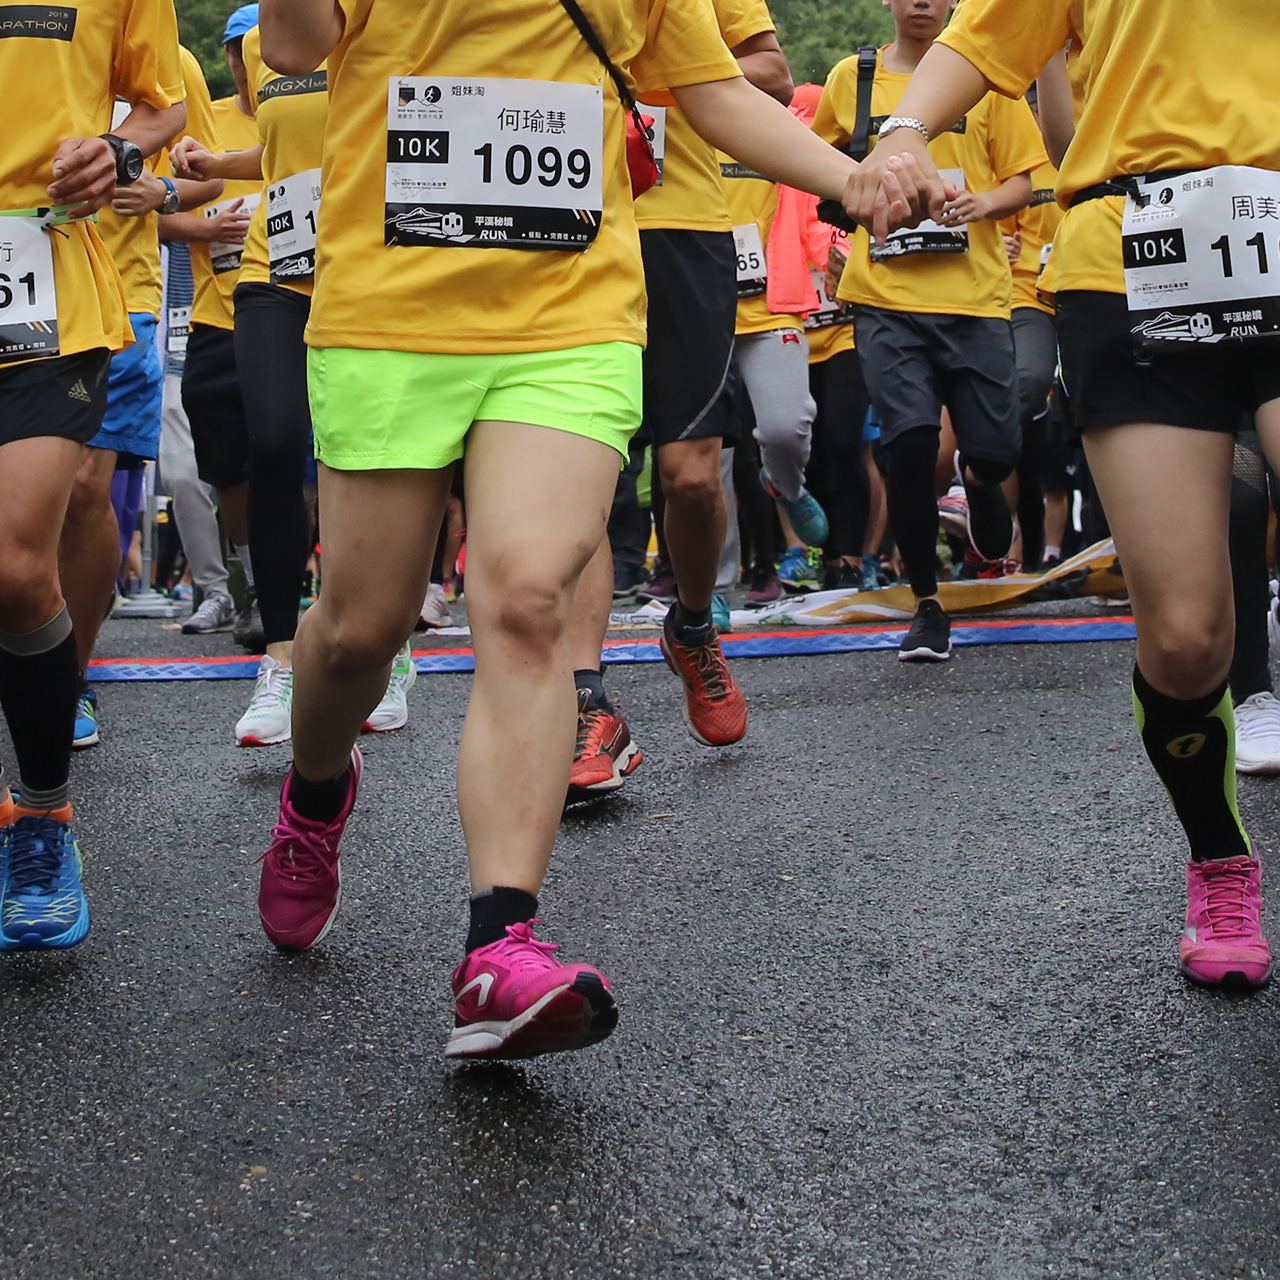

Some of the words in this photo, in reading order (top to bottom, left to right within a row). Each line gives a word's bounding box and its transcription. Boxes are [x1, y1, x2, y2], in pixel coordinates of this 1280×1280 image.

[48, 11, 69, 19] 2018
[451, 85, 485, 97] 姐妹淘
[497, 107, 566, 135] 何瑜慧
[398, 137, 440, 157] 10K
[474, 142, 591, 189] 1099
[270, 216, 290, 232] 10K
[479, 230, 508, 240] RUN
[1132, 237, 1177, 261] 10K
[736, 252, 760, 271] 65
[1230, 325, 1259, 337] RUN
